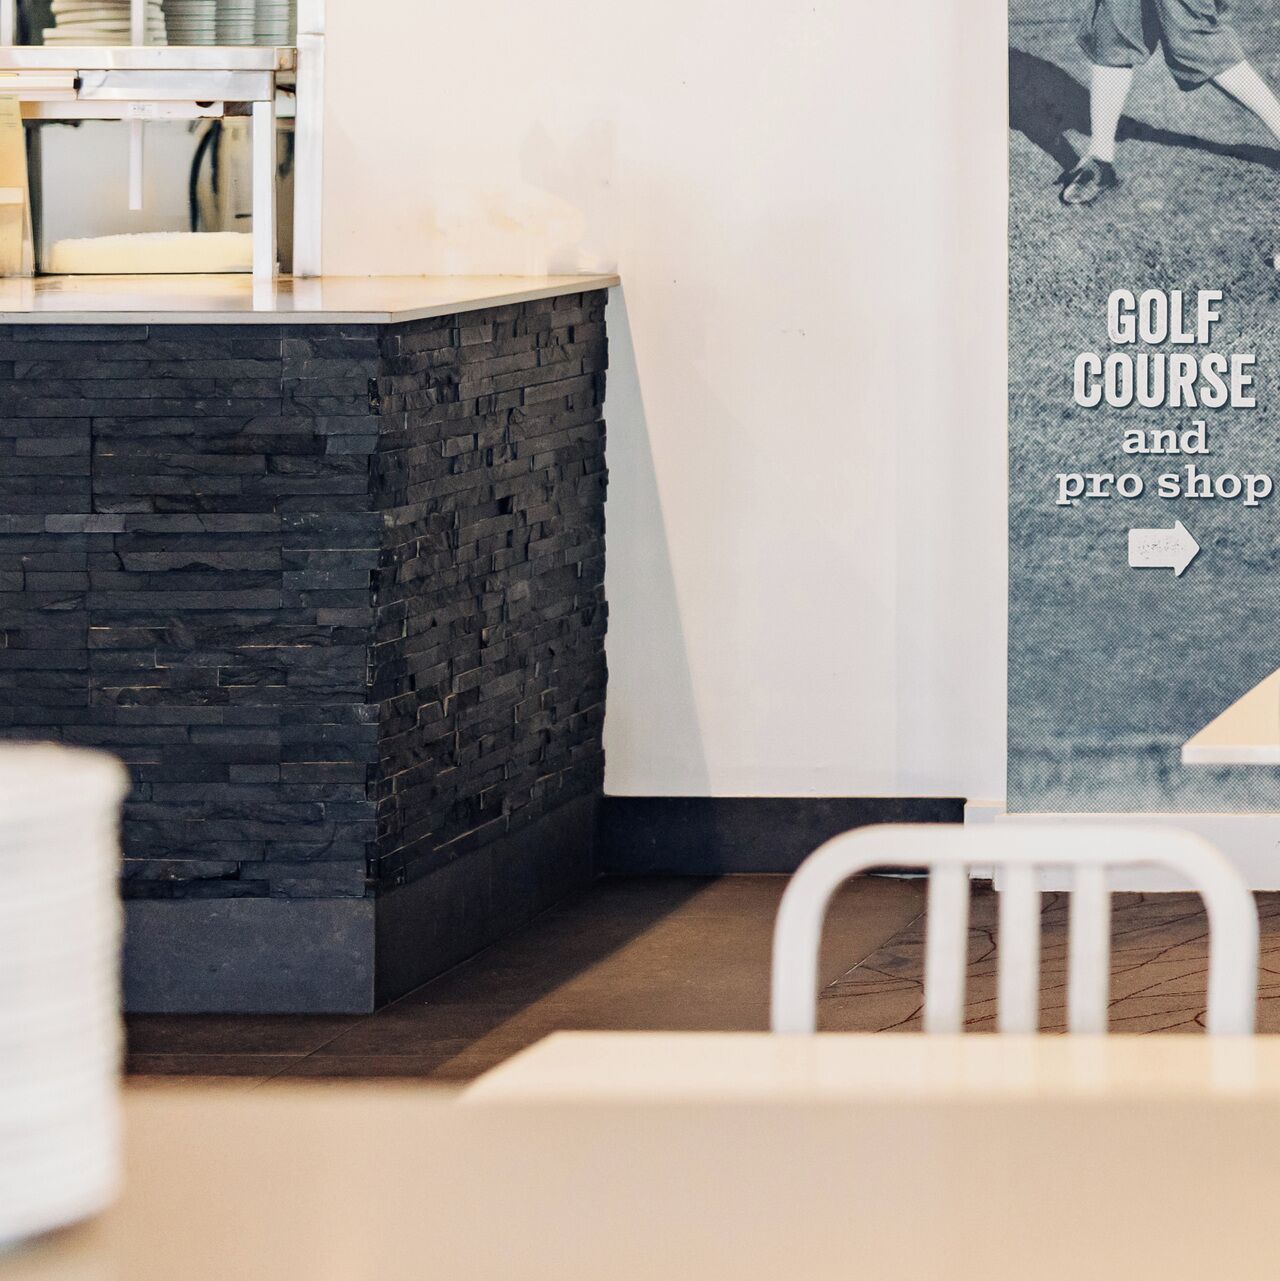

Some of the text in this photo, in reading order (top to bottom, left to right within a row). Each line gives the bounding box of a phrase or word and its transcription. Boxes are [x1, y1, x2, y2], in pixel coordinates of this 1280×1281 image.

[1107, 288, 1224, 345] GOLF
[1073, 352, 1257, 408] COURSE
[1121, 420, 1210, 455] and
[1055, 464, 1274, 507] pro shop
